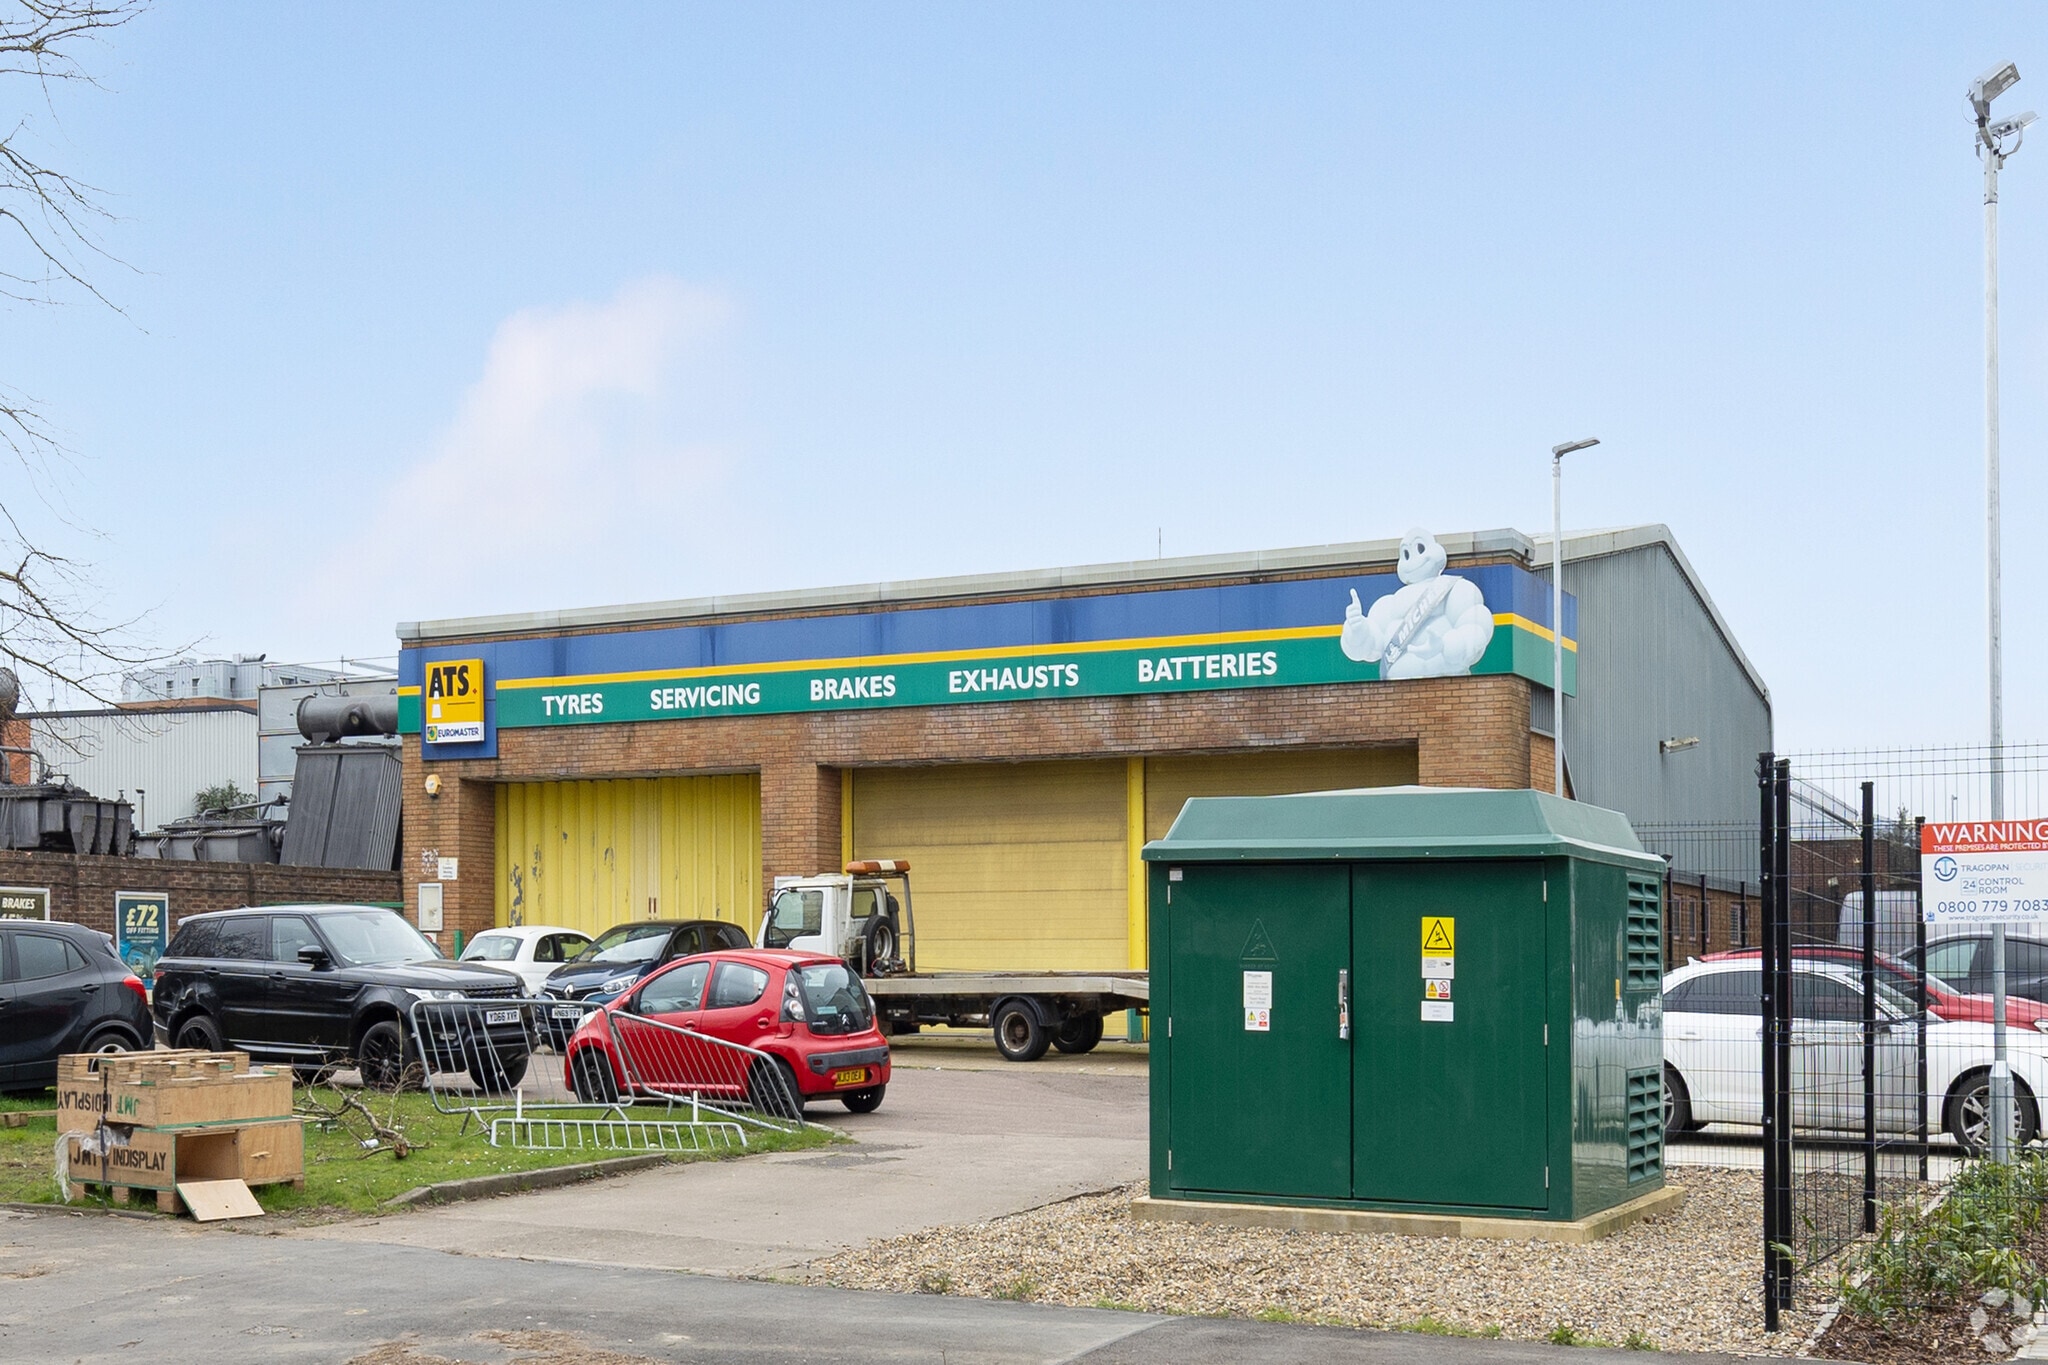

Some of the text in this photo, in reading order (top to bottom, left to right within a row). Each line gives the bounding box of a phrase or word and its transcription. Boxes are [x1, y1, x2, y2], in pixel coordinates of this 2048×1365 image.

[428, 665, 470, 698] ATS
[541, 651, 1278, 717] TYRES SERVICING BRAKES EXHAUSTS BATTERIES
[438, 727, 480, 738] EUROMASTER
[1932, 821, 2048, 844] WARNING
[1933, 844, 1953, 852] THESE
[1955, 843, 1984, 851] PREMISES
[1986, 842, 1998, 850] ARE
[2000, 842, 2041, 850] PROTECTED
[1961, 862, 2048, 872] TRAGOPAN SECURIT
[1962, 880, 1976, 890] 24
[1978, 877, 2024, 886] CONTROL
[1979, 886, 2008, 894] ROOM
[2, 897, 36, 910] BRAKES
[1937, 899, 2048, 913] 0800 779 7083
[125, 904, 159, 927] £72
[117, 1095, 140, 1116] JMT
[113, 1148, 166, 1171] INDISPLAY
